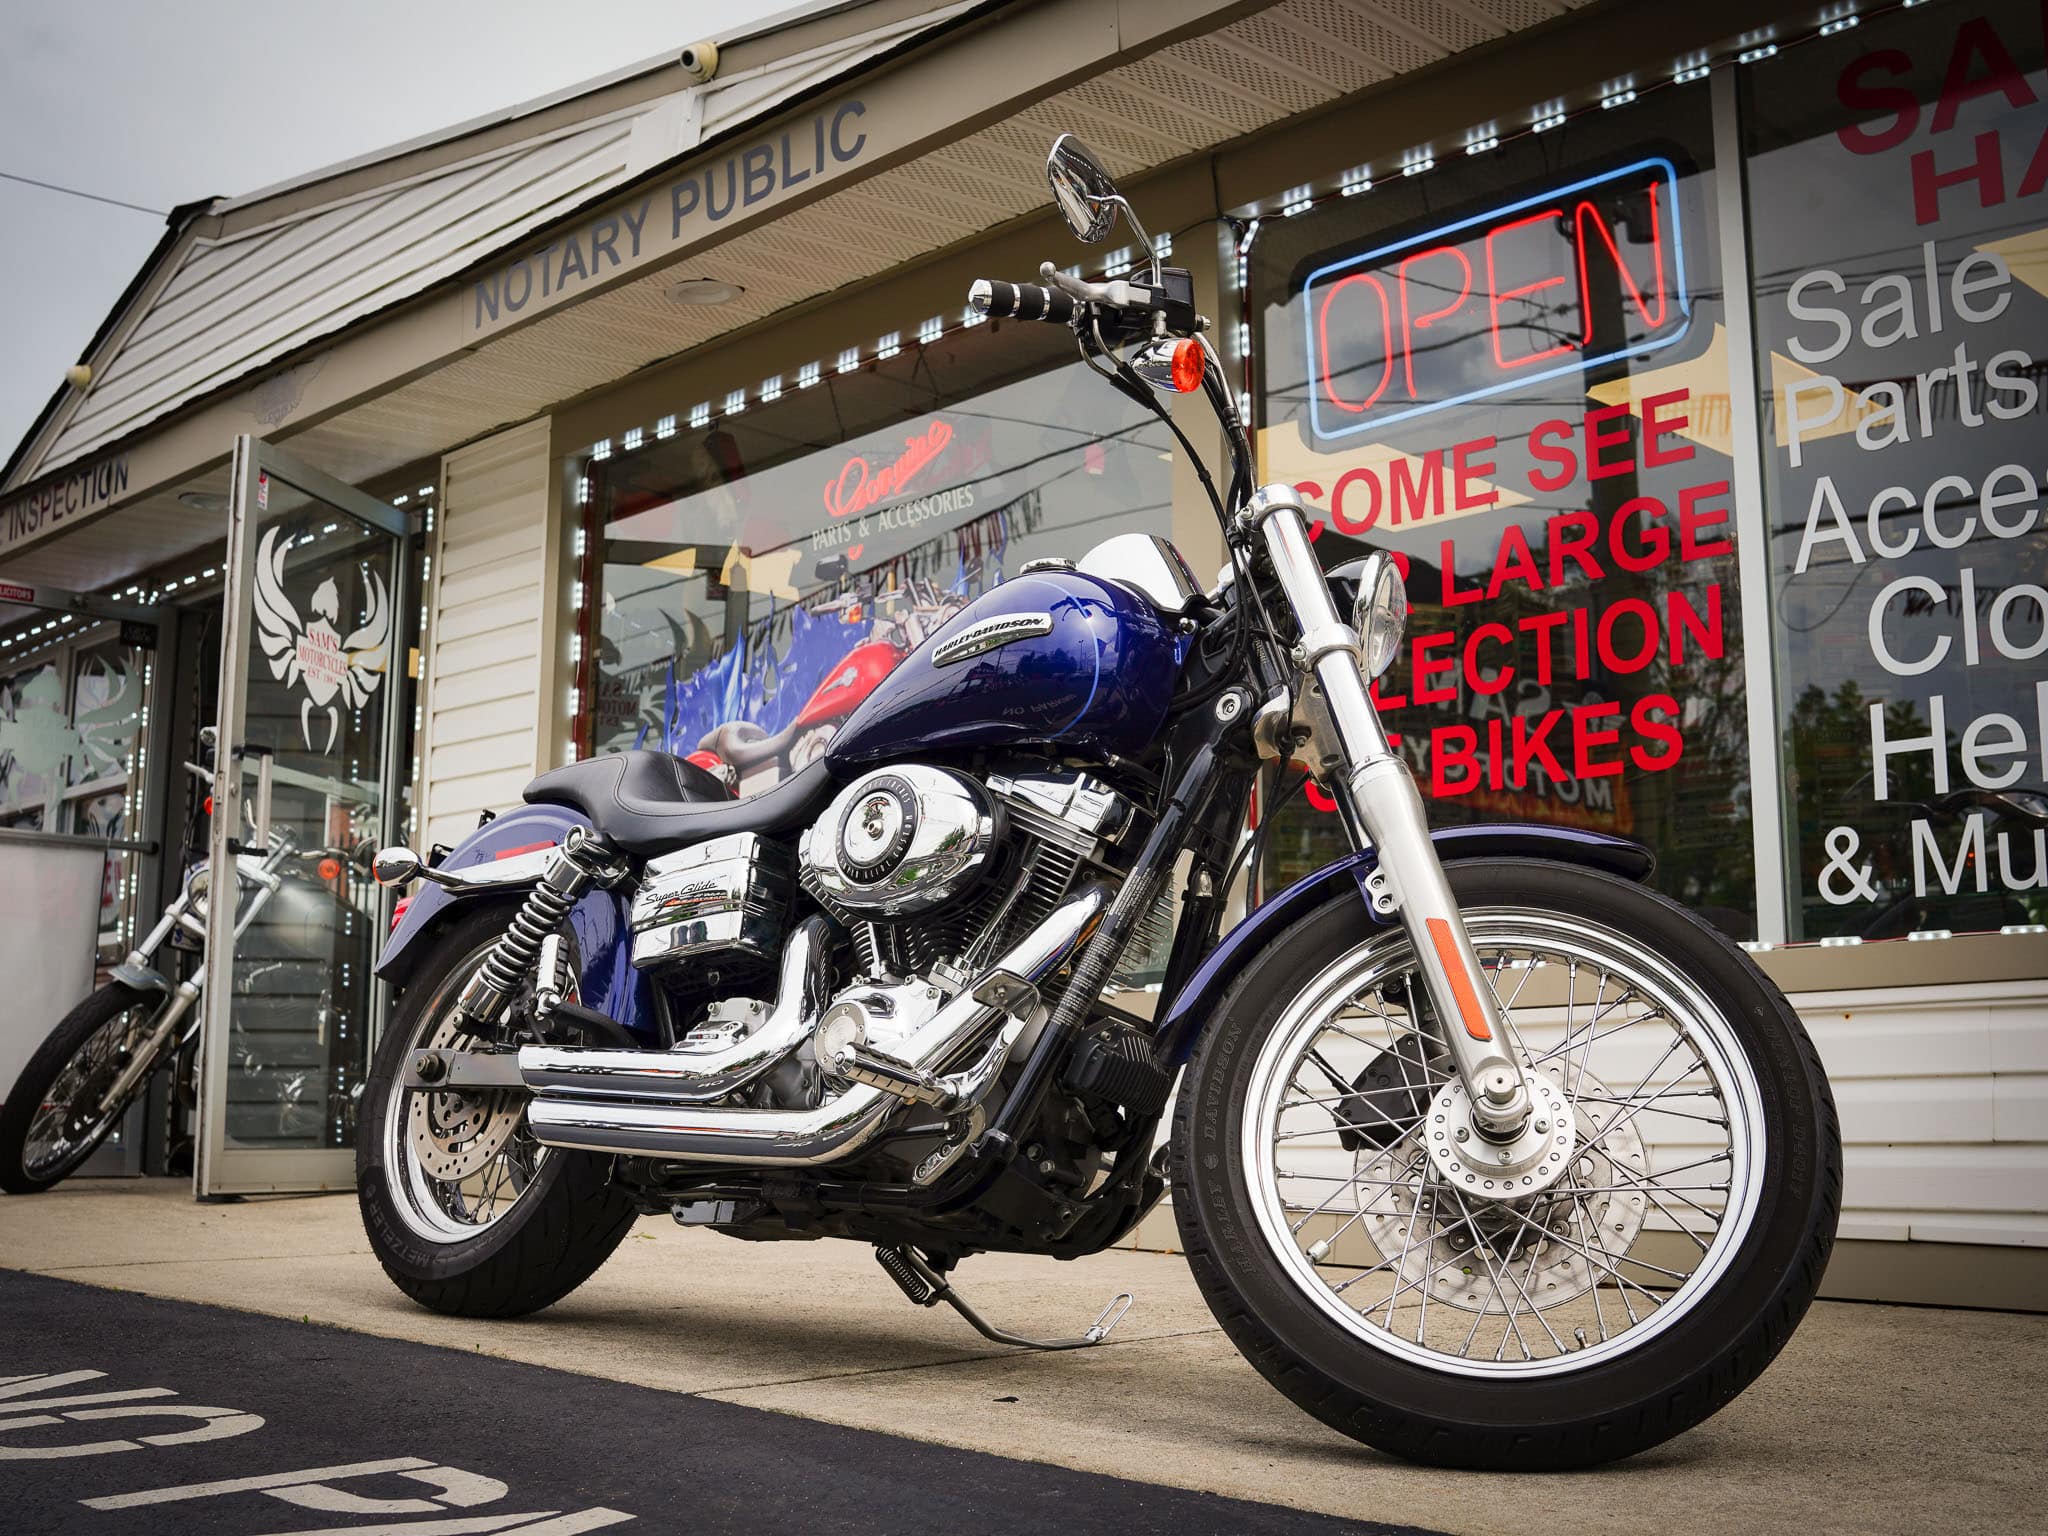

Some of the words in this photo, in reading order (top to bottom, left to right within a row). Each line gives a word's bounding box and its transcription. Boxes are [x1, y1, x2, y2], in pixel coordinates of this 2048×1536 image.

[1836, 14, 2048, 155] SA
[474, 198, 656, 329] NOTARY
[671, 100, 868, 240] PUBLIC
[1319, 180, 1667, 412] OPEN
[1786, 240, 2012, 364] Sale
[1527, 388, 1696, 492] SEE
[1784, 341, 2040, 468] Parts
[9, 453, 130, 542] INSPECTION
[811, 520, 852, 551] PARTS
[858, 516, 870, 538] &
[877, 484, 975, 532] ACCESSORIES
[1440, 481, 1734, 609] LARGE
[298, 644, 348, 677] MOTORCYCLES
[308, 628, 338, 655] SAM'S
[934, 618, 1044, 658] HARLEY-DAVIDSON
[1867, 567, 2048, 676] Clo
[1430, 693, 1685, 798] BIKES
[641, 890, 681, 907] Super
[680, 880, 718, 895] Glide
[1818, 825, 1879, 906] &
[1910, 813, 2048, 898] Mu
[1203, 1020, 1243, 1142] DAVIDSON
[368, 1200, 432, 1268] METZELER
